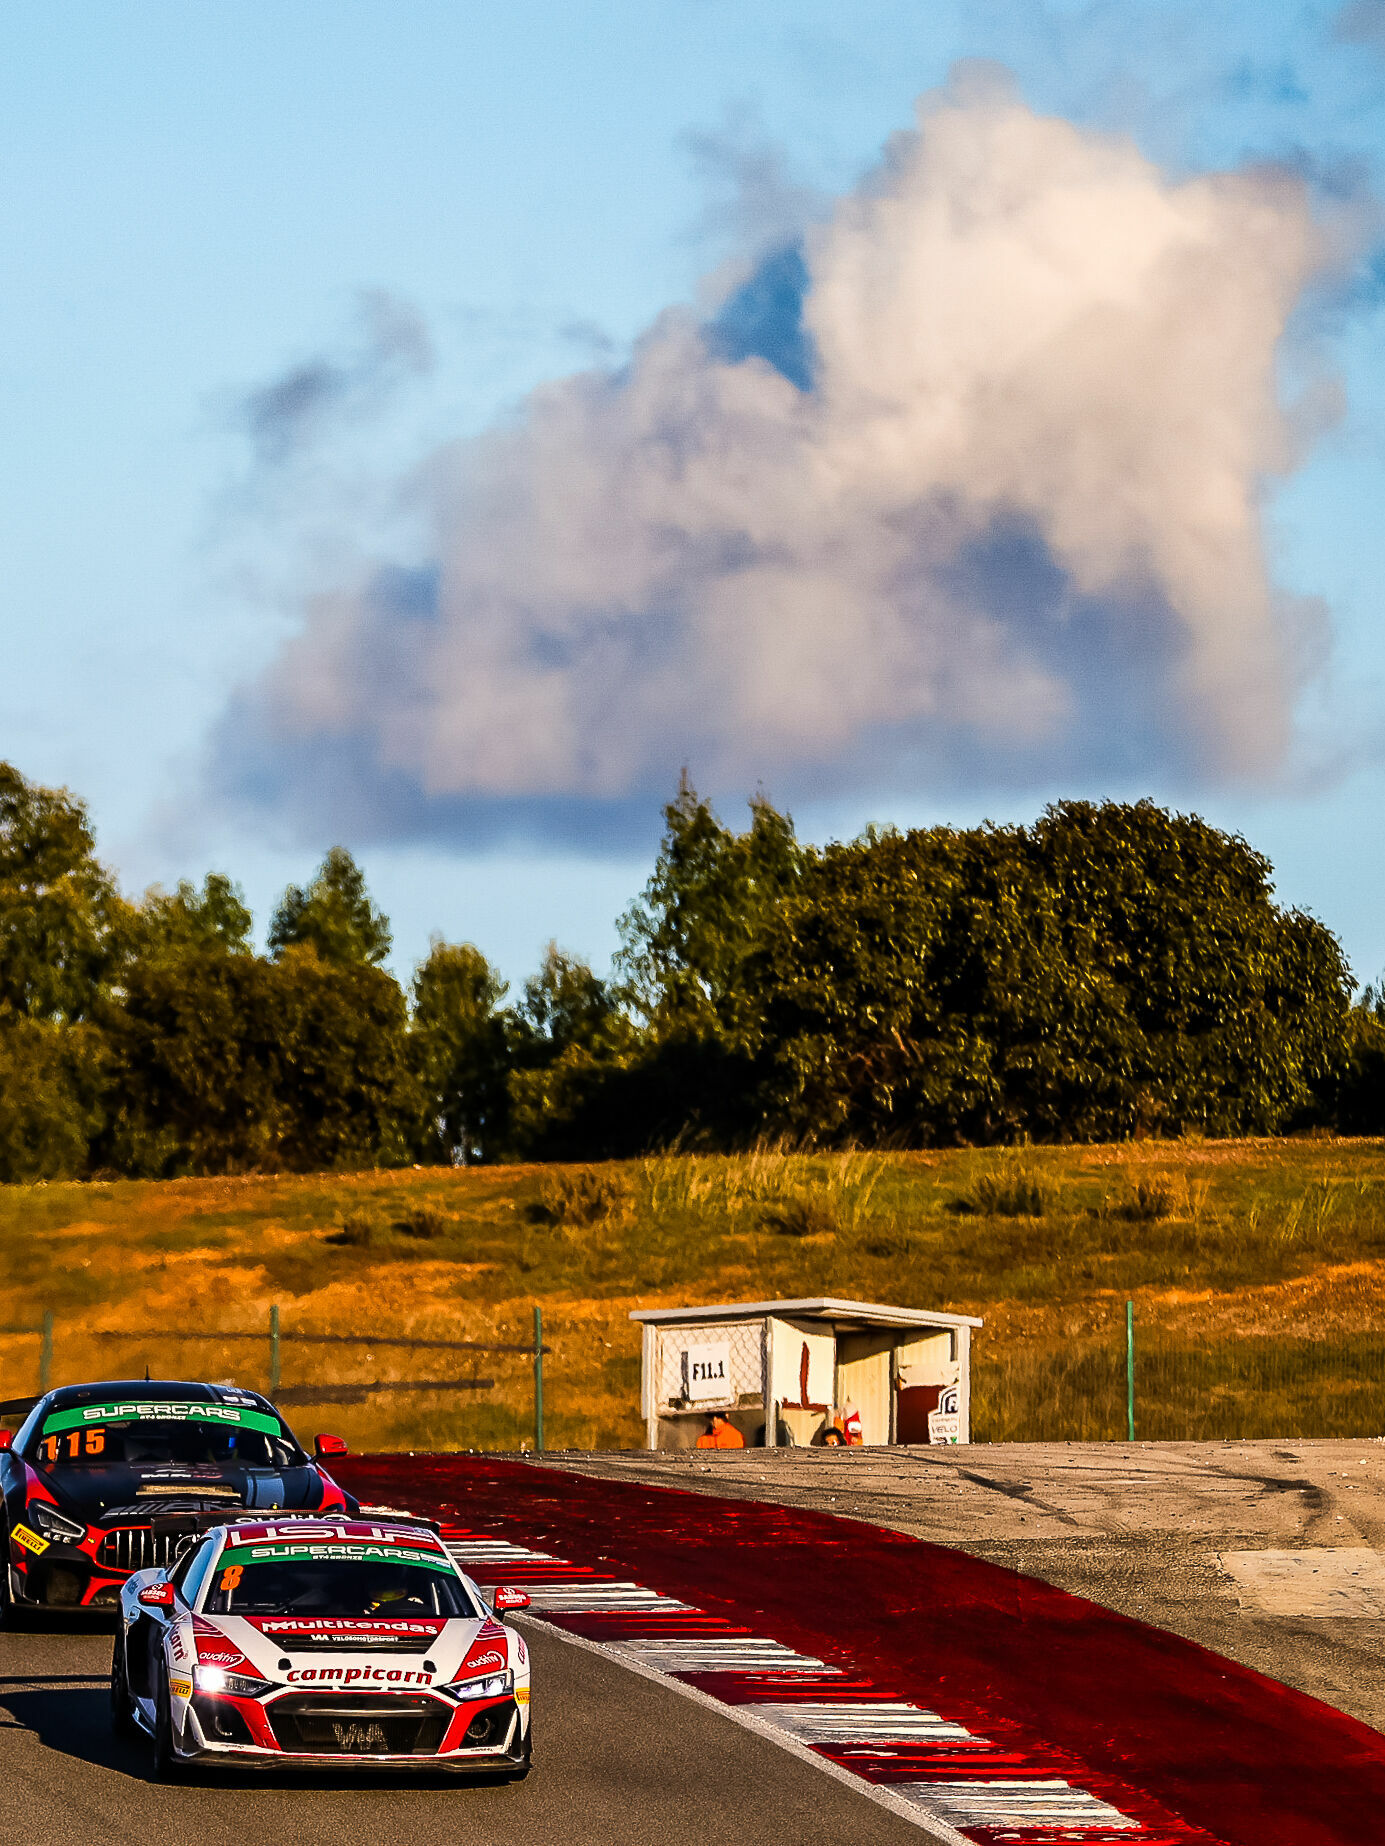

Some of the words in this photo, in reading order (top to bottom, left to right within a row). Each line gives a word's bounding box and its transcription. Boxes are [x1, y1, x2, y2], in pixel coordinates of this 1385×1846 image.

[692, 1360, 725, 1380] F11.1
[82, 1404, 242, 1421] SUPERCARS
[44, 1428, 106, 1461] 115
[15, 1527, 44, 1551] PIRELLI
[251, 1545, 421, 1562] SUPERCARS
[220, 1564, 244, 1591] 8
[286, 1665, 433, 1685] campicarn
